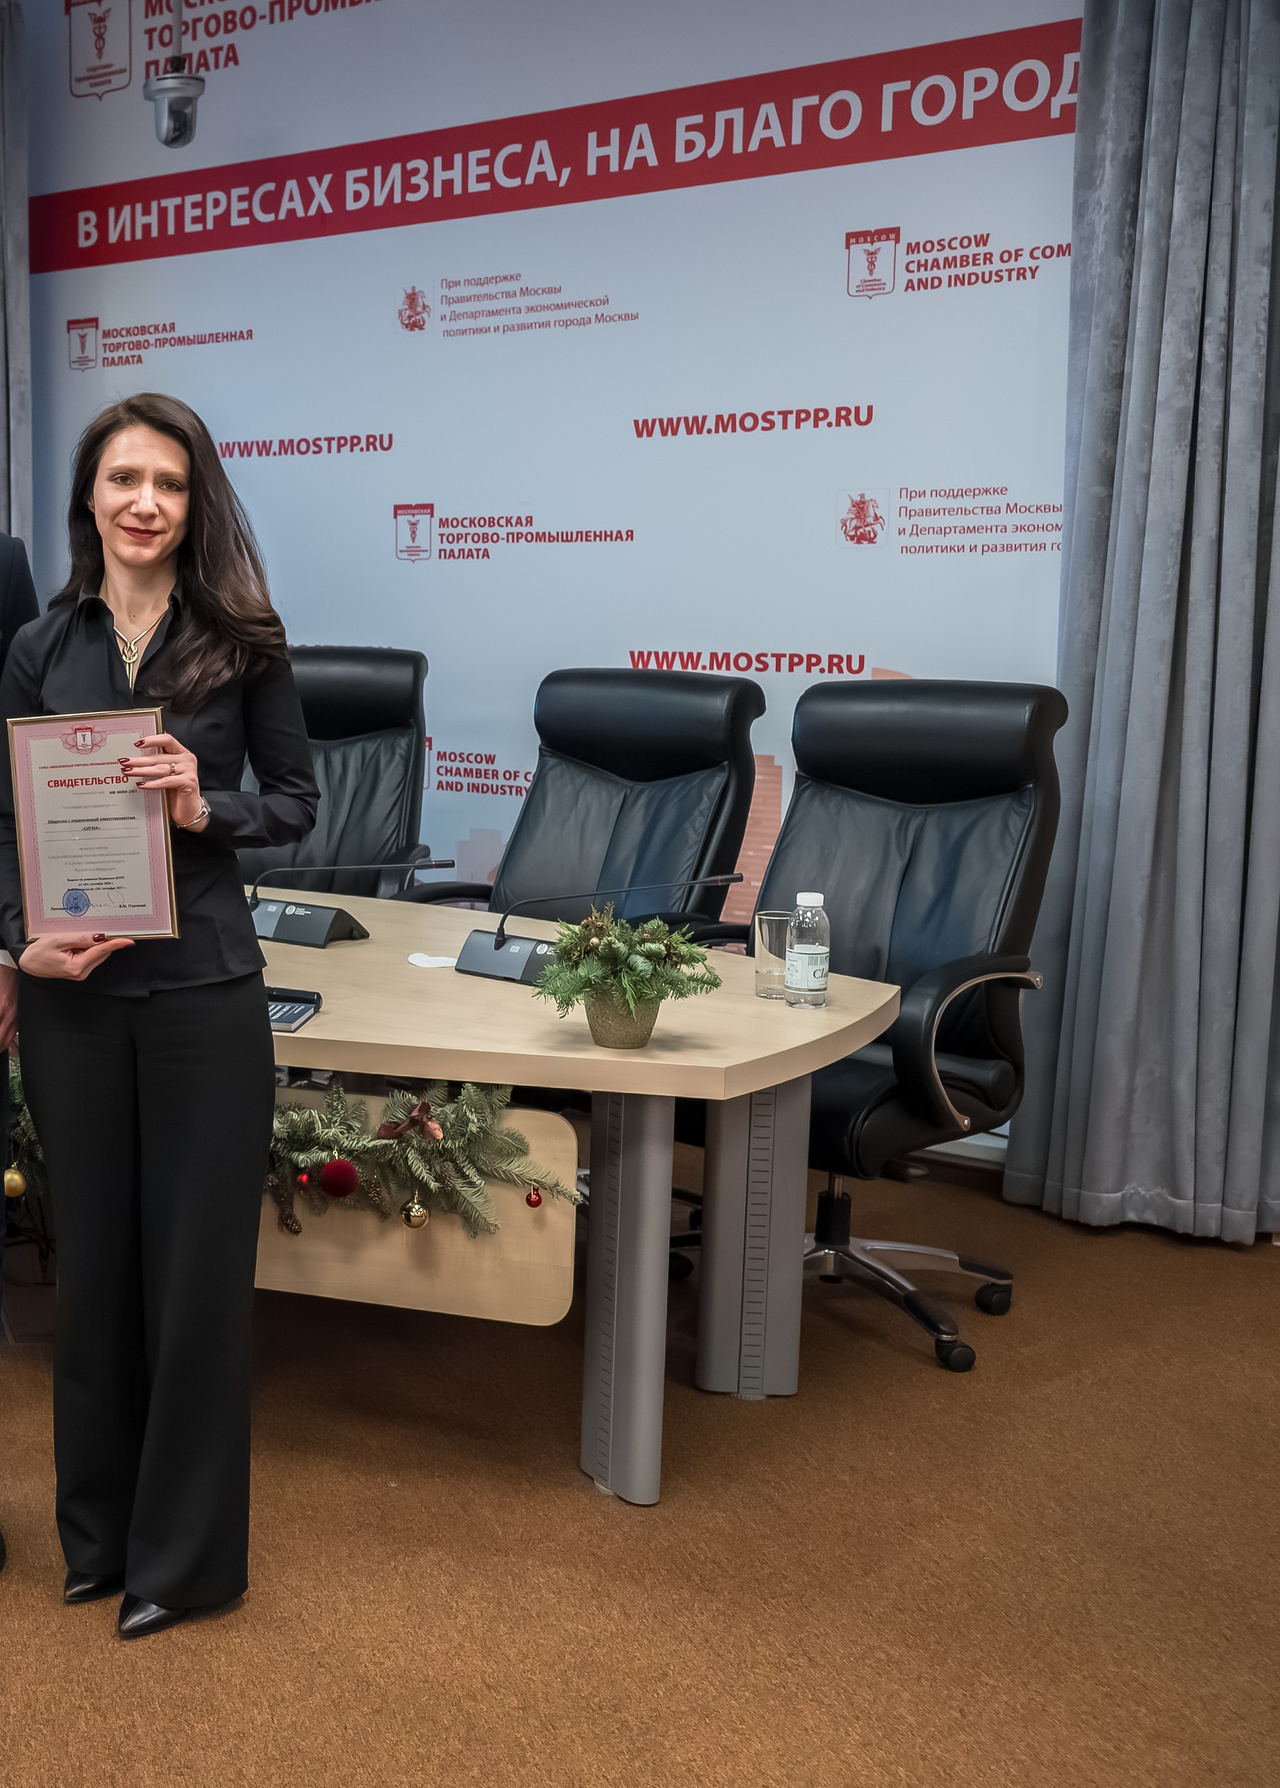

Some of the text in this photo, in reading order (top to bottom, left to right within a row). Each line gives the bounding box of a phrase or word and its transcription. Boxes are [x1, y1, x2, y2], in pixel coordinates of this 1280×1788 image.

[77, 210, 99, 248] В
[108, 173, 334, 244] ИНТЕРЕСАХ
[345, 139, 571, 211] БИЗНЕСА,
[586, 122, 659, 177] НА
[674, 89, 863, 164] БЛАГО
[906, 233, 991, 256] MOSCOW
[905, 251, 994, 274] CHAMBER
[999, 248, 1024, 264] OF
[440, 272, 522, 290] При поддержке
[904, 265, 1040, 292] AND INDUSTRY
[440, 285, 562, 307] Правительства Москвы
[440, 294, 610, 323] и Департамента экономической
[102, 322, 176, 340] МОСКОВСКАЯ
[442, 310, 639, 338] политики и развития города Москвы
[102, 329, 253, 354] ТОРГОВО-ПРОМЫШЛЕННАЯ
[102, 354, 143, 368] ПАЛАТА
[633, 405, 874, 439] WWW.MOSTPP.RU
[218, 433, 394, 459] WWW.MOSTPP.RU
[899, 485, 1008, 501] При поддержке
[898, 502, 1063, 519] Правительства Москвы
[438, 515, 533, 529] МОСКОВСКАЯ
[898, 527, 906, 536] и
[909, 523, 1008, 538] Департамента
[438, 529, 635, 545] ТОРГОВО-ПРОМЫШЛЕННАЯ
[438, 548, 490, 560] ПАЛАТА
[900, 544, 966, 555] политики
[969, 543, 977, 553] и
[981, 541, 1047, 556] развития
[629, 650, 865, 675] WWW.MOSTPP.RU
[436, 751, 496, 765] MOSCOW
[47, 775, 129, 789] СВИДЕТЕЛЬСТВО
[436, 765, 536, 783] CHAMBER OF C
[436, 780, 464, 793] AND
